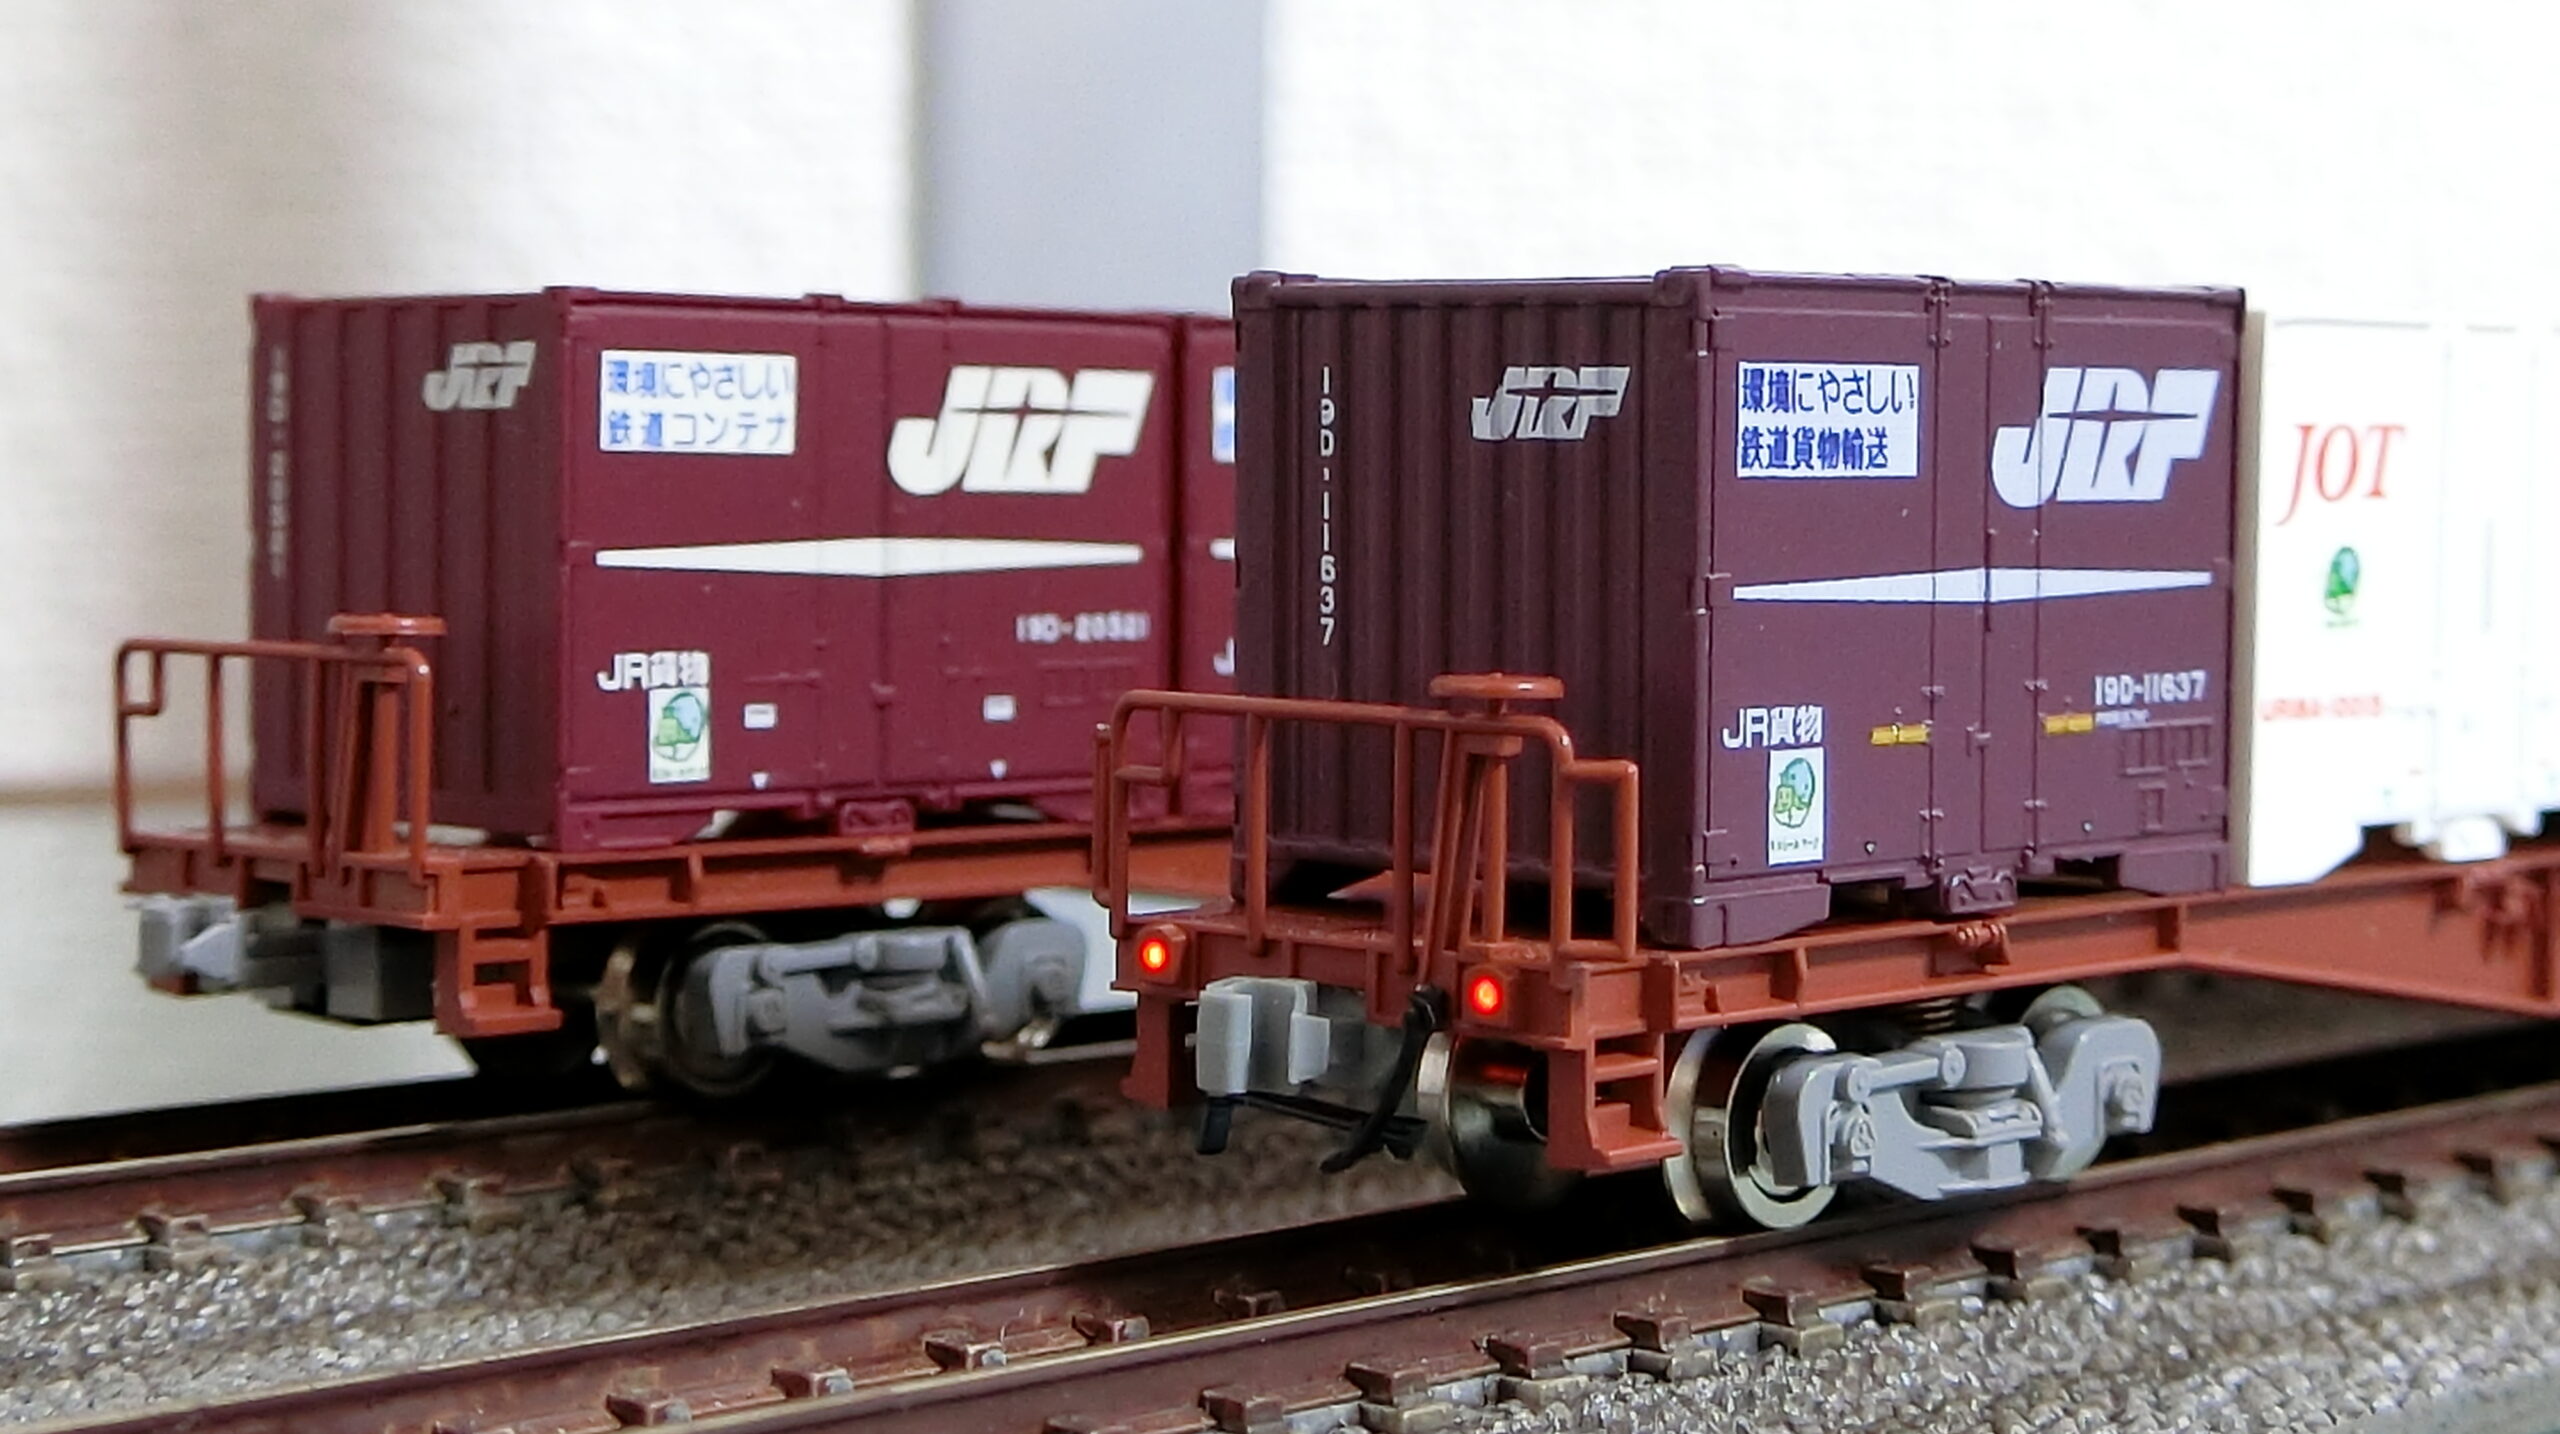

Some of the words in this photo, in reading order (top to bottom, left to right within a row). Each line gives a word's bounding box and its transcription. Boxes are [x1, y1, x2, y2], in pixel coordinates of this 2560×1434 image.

[887, 365, 1156, 496] JRF
[1470, 366, 1631, 441] JRF
[1740, 368, 1915, 415] 環境にやさしい
[1740, 425, 1889, 471] 鉄道貨物輸送
[1991, 368, 2221, 508] JRF
[2274, 424, 2407, 527] JOT
